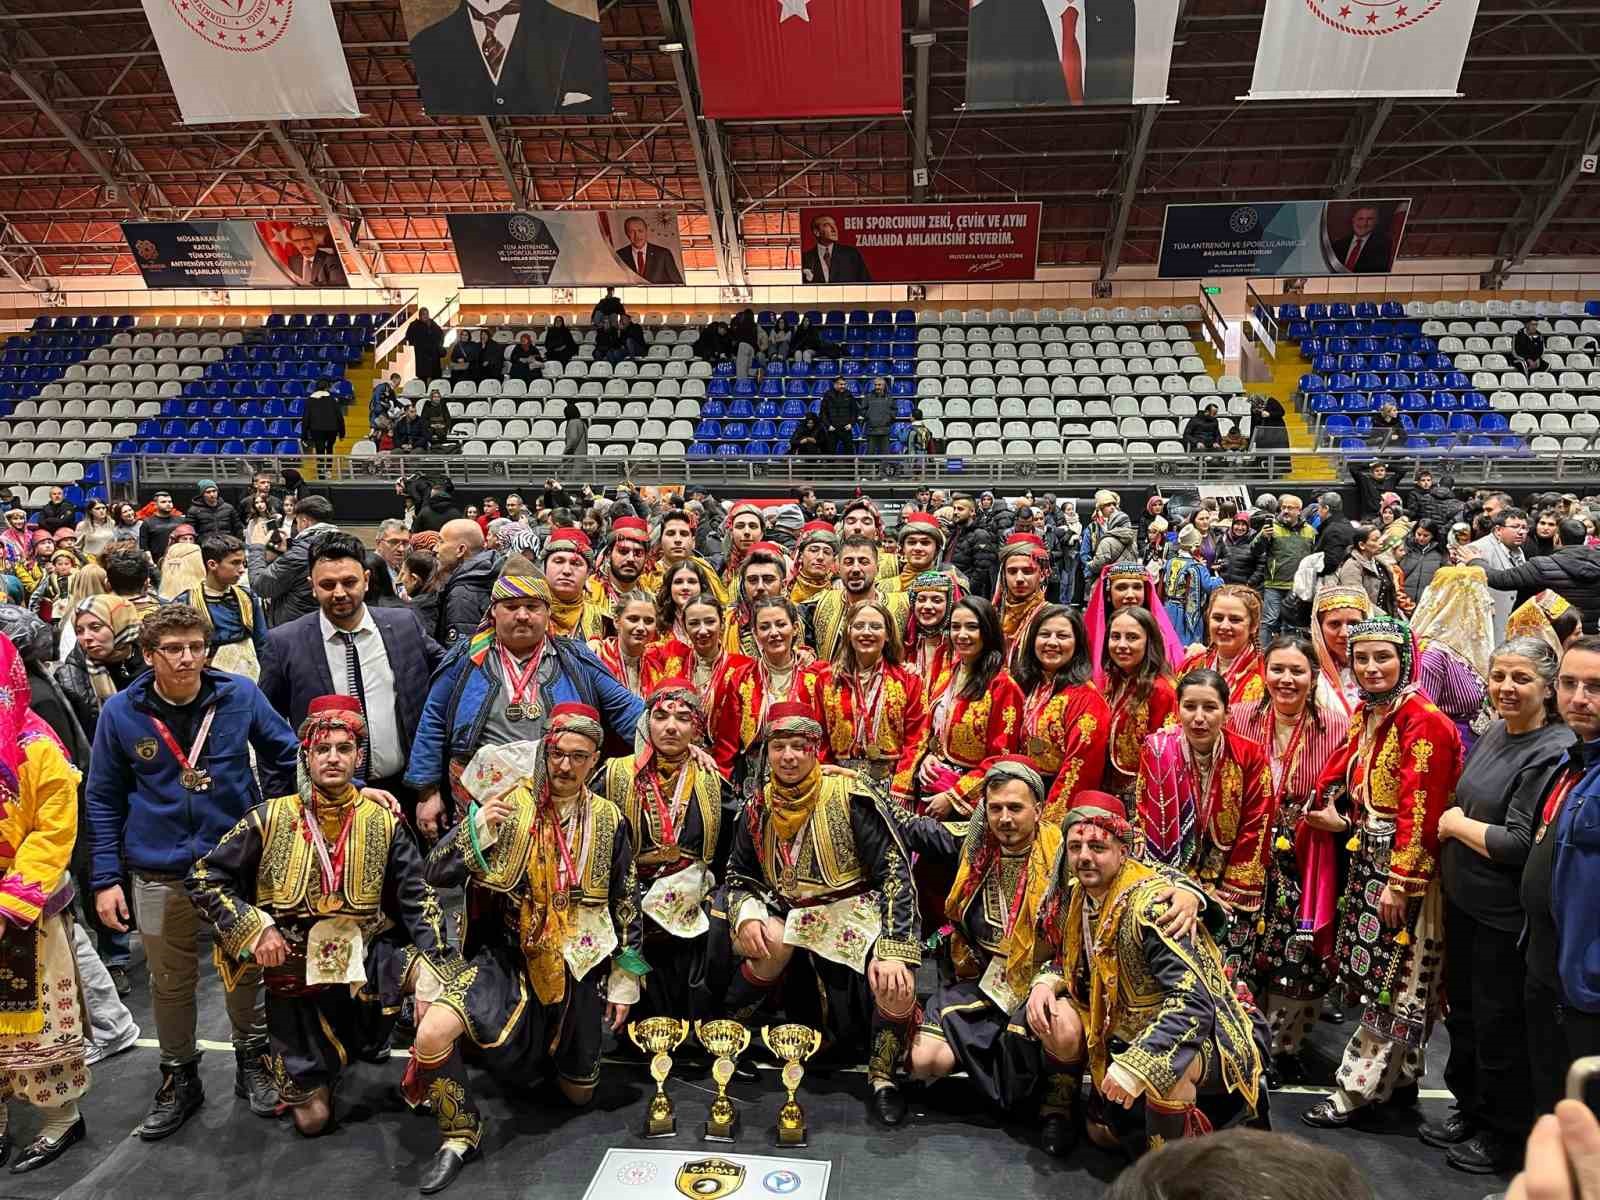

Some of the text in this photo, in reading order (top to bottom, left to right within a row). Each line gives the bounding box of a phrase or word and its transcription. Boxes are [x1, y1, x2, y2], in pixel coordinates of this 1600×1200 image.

[1583, 158, 1594, 170] G
[916, 172, 925, 184] F
[844, 216, 864, 230] BEN
[866, 215, 926, 230] SPORCUNUN
[956, 211, 985, 231] ÇEVİK
[988, 214, 1001, 228] VE
[1002, 214, 1028, 228] AYNI
[855, 233, 904, 247] ZAMANDA
[905, 232, 967, 246] AHLAKLISINI
